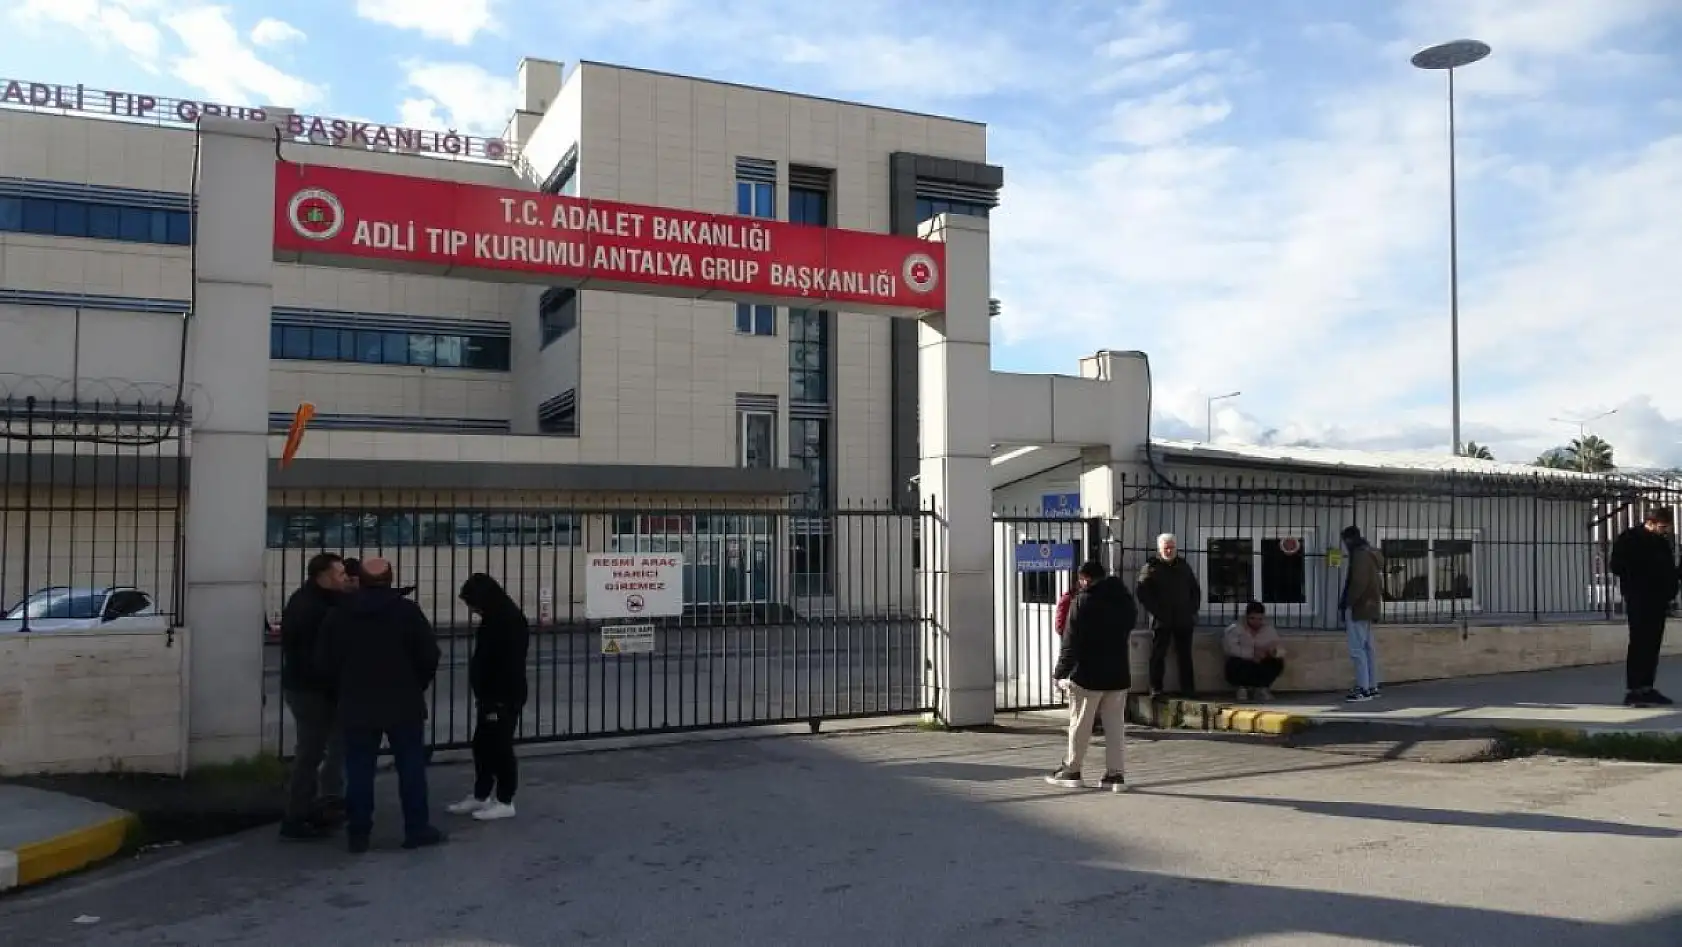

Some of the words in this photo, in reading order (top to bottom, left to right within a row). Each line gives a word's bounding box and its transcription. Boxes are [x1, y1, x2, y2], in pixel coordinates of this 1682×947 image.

[4, 80, 84, 110] ADLİ
[104, 91, 156, 117] TIP
[500, 198, 544, 226] T.C.
[551, 204, 644, 238] ADALET
[653, 217, 771, 253] BAKANLIĞI
[353, 220, 415, 252] ADLİ
[426, 228, 468, 255] TIP
[475, 233, 584, 268] KURUMU
[593, 245, 694, 278] ANTALYA
[701, 258, 760, 284] GRUP
[770, 265, 896, 299] BAŞKANLIĞI
[593, 556, 635, 567] RESMİ
[641, 558, 677, 567] ARAÇ
